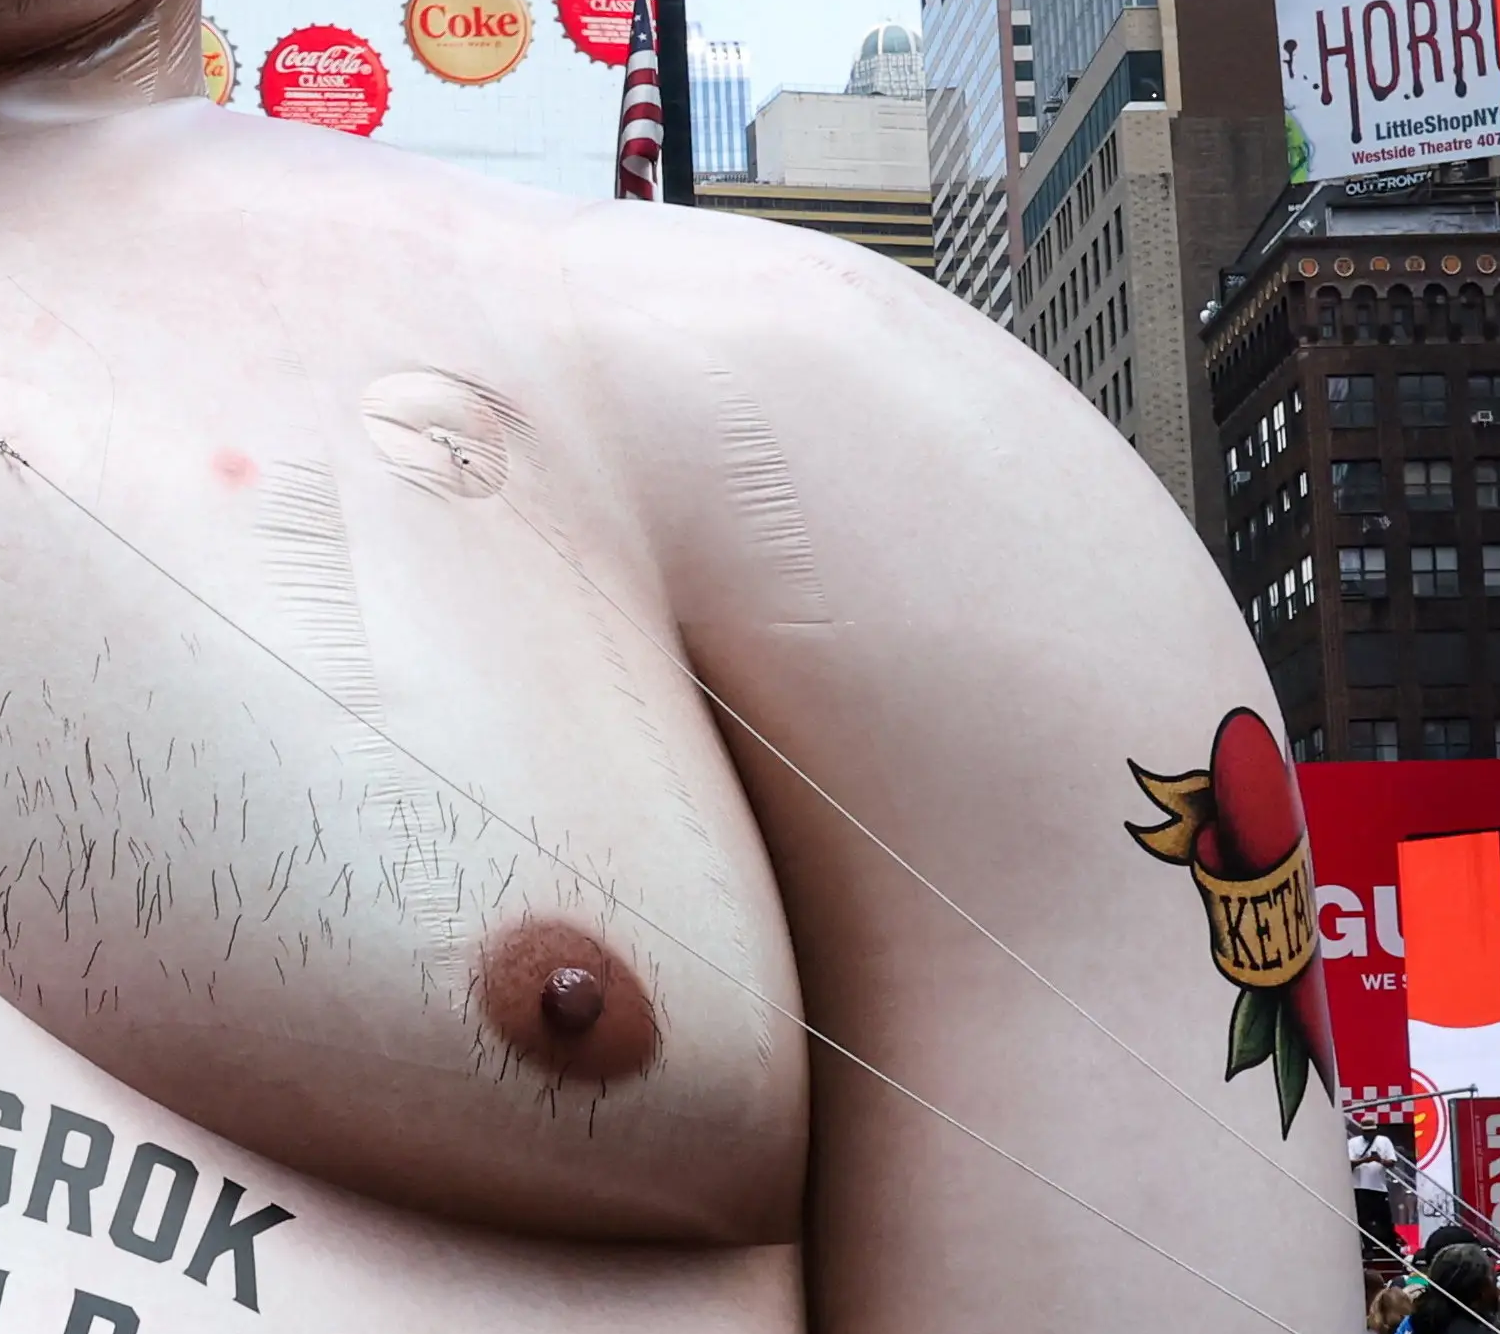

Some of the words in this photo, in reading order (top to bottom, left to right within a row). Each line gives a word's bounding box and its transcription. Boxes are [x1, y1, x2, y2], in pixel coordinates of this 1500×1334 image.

[419, 4, 520, 40] Coke
[298, 74, 351, 88] CLASSIC
[1352, 144, 1416, 166] Westside
[1419, 136, 1473, 157] Theatre
[1361, 973, 1397, 991] WE
